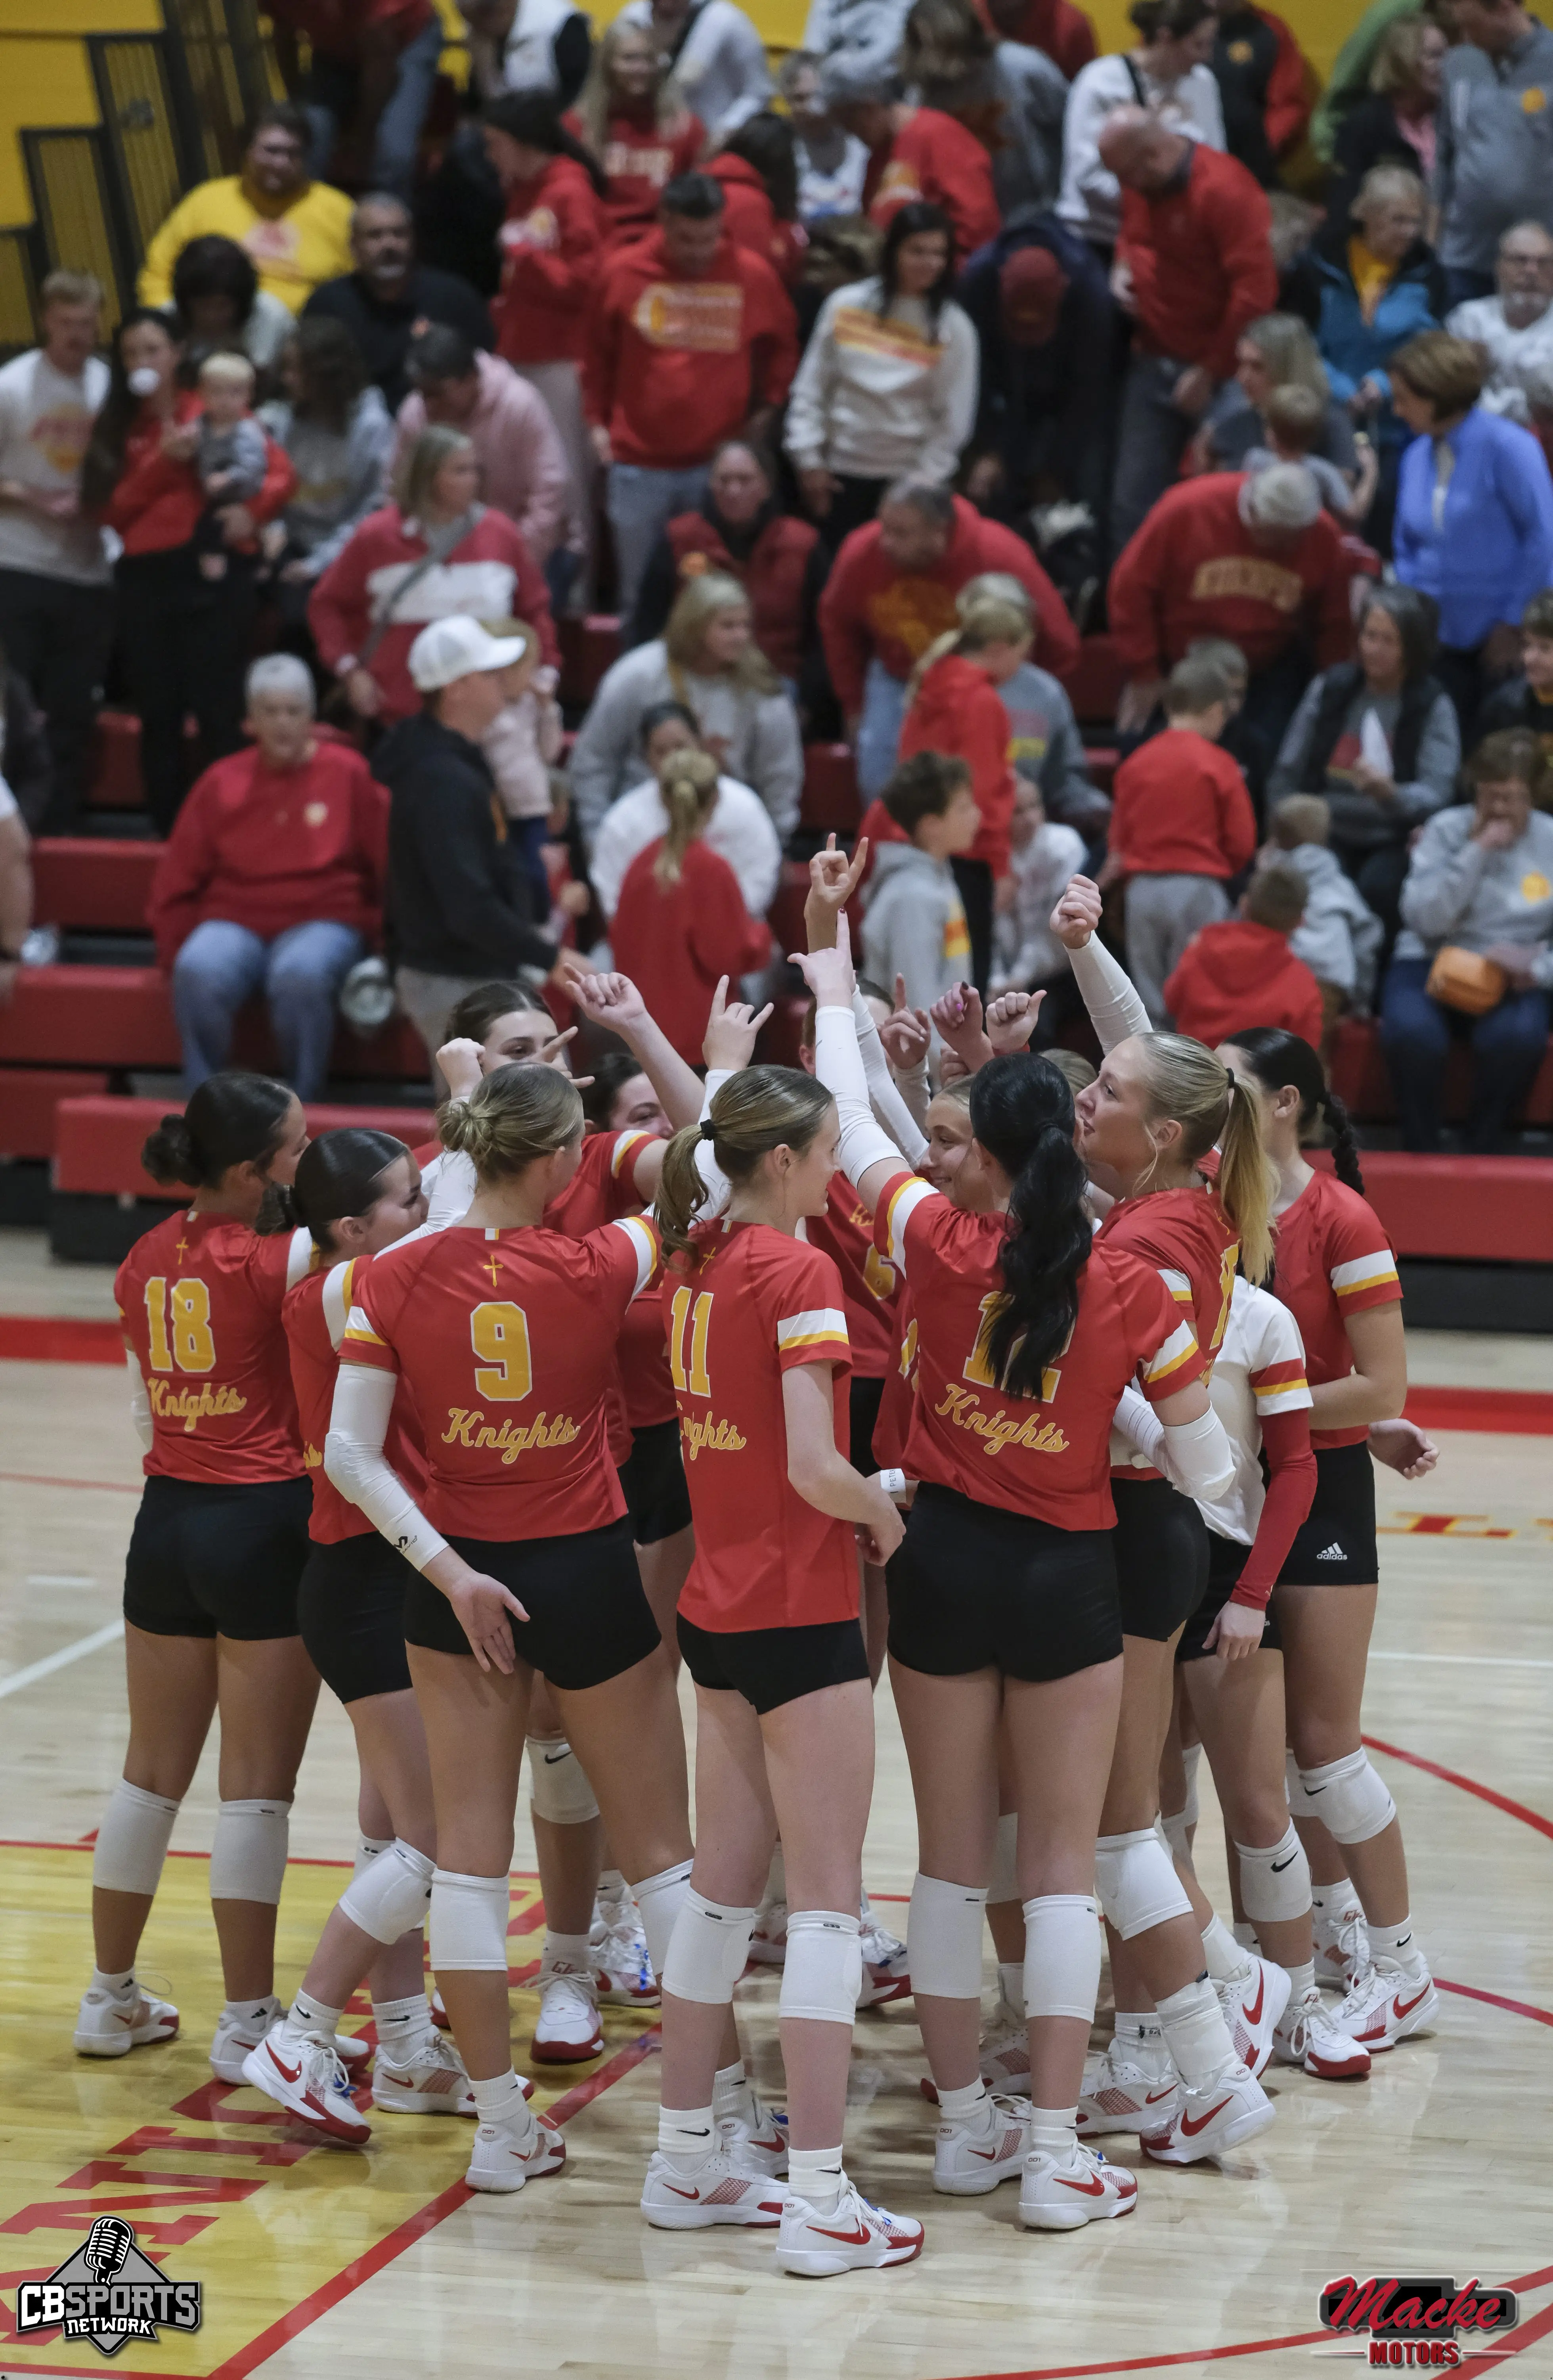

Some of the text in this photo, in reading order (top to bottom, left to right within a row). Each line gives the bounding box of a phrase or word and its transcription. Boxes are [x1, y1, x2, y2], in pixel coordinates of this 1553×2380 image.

[144, 1277, 216, 1373] 18
[470, 1301, 533, 1401] 9
[670, 1286, 714, 1398] 11
[148, 1377, 247, 1432] Knights
[441, 1407, 581, 1464] Knights
[935, 1384, 1070, 1455] Knights
